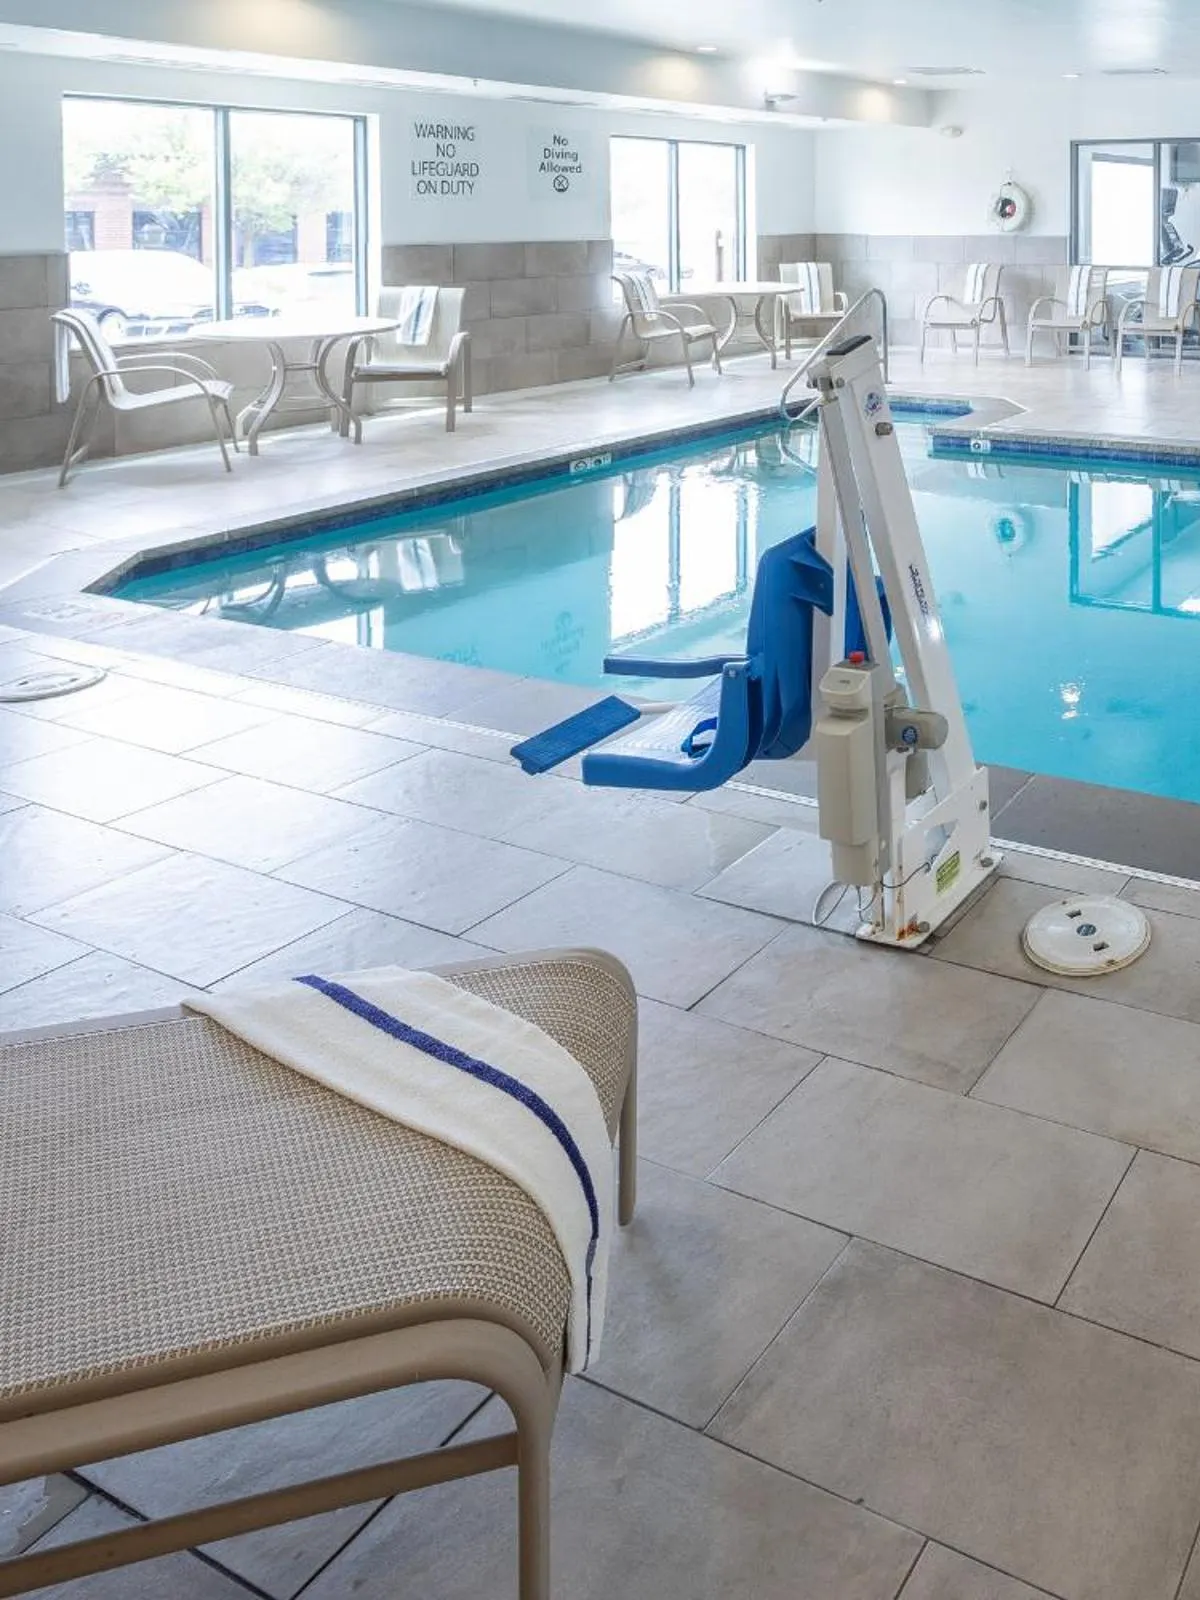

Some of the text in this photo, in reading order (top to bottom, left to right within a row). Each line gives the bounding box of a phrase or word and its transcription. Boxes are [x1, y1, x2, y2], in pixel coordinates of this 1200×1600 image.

[415, 122, 474, 141] WARNING
[553, 135, 568, 146] No
[436, 143, 457, 159] NO
[543, 147, 579, 162] Diving
[412, 161, 479, 177] LIFEGUARD
[539, 162, 582, 174] Allowed
[416, 179, 474, 195] ON DUTY
